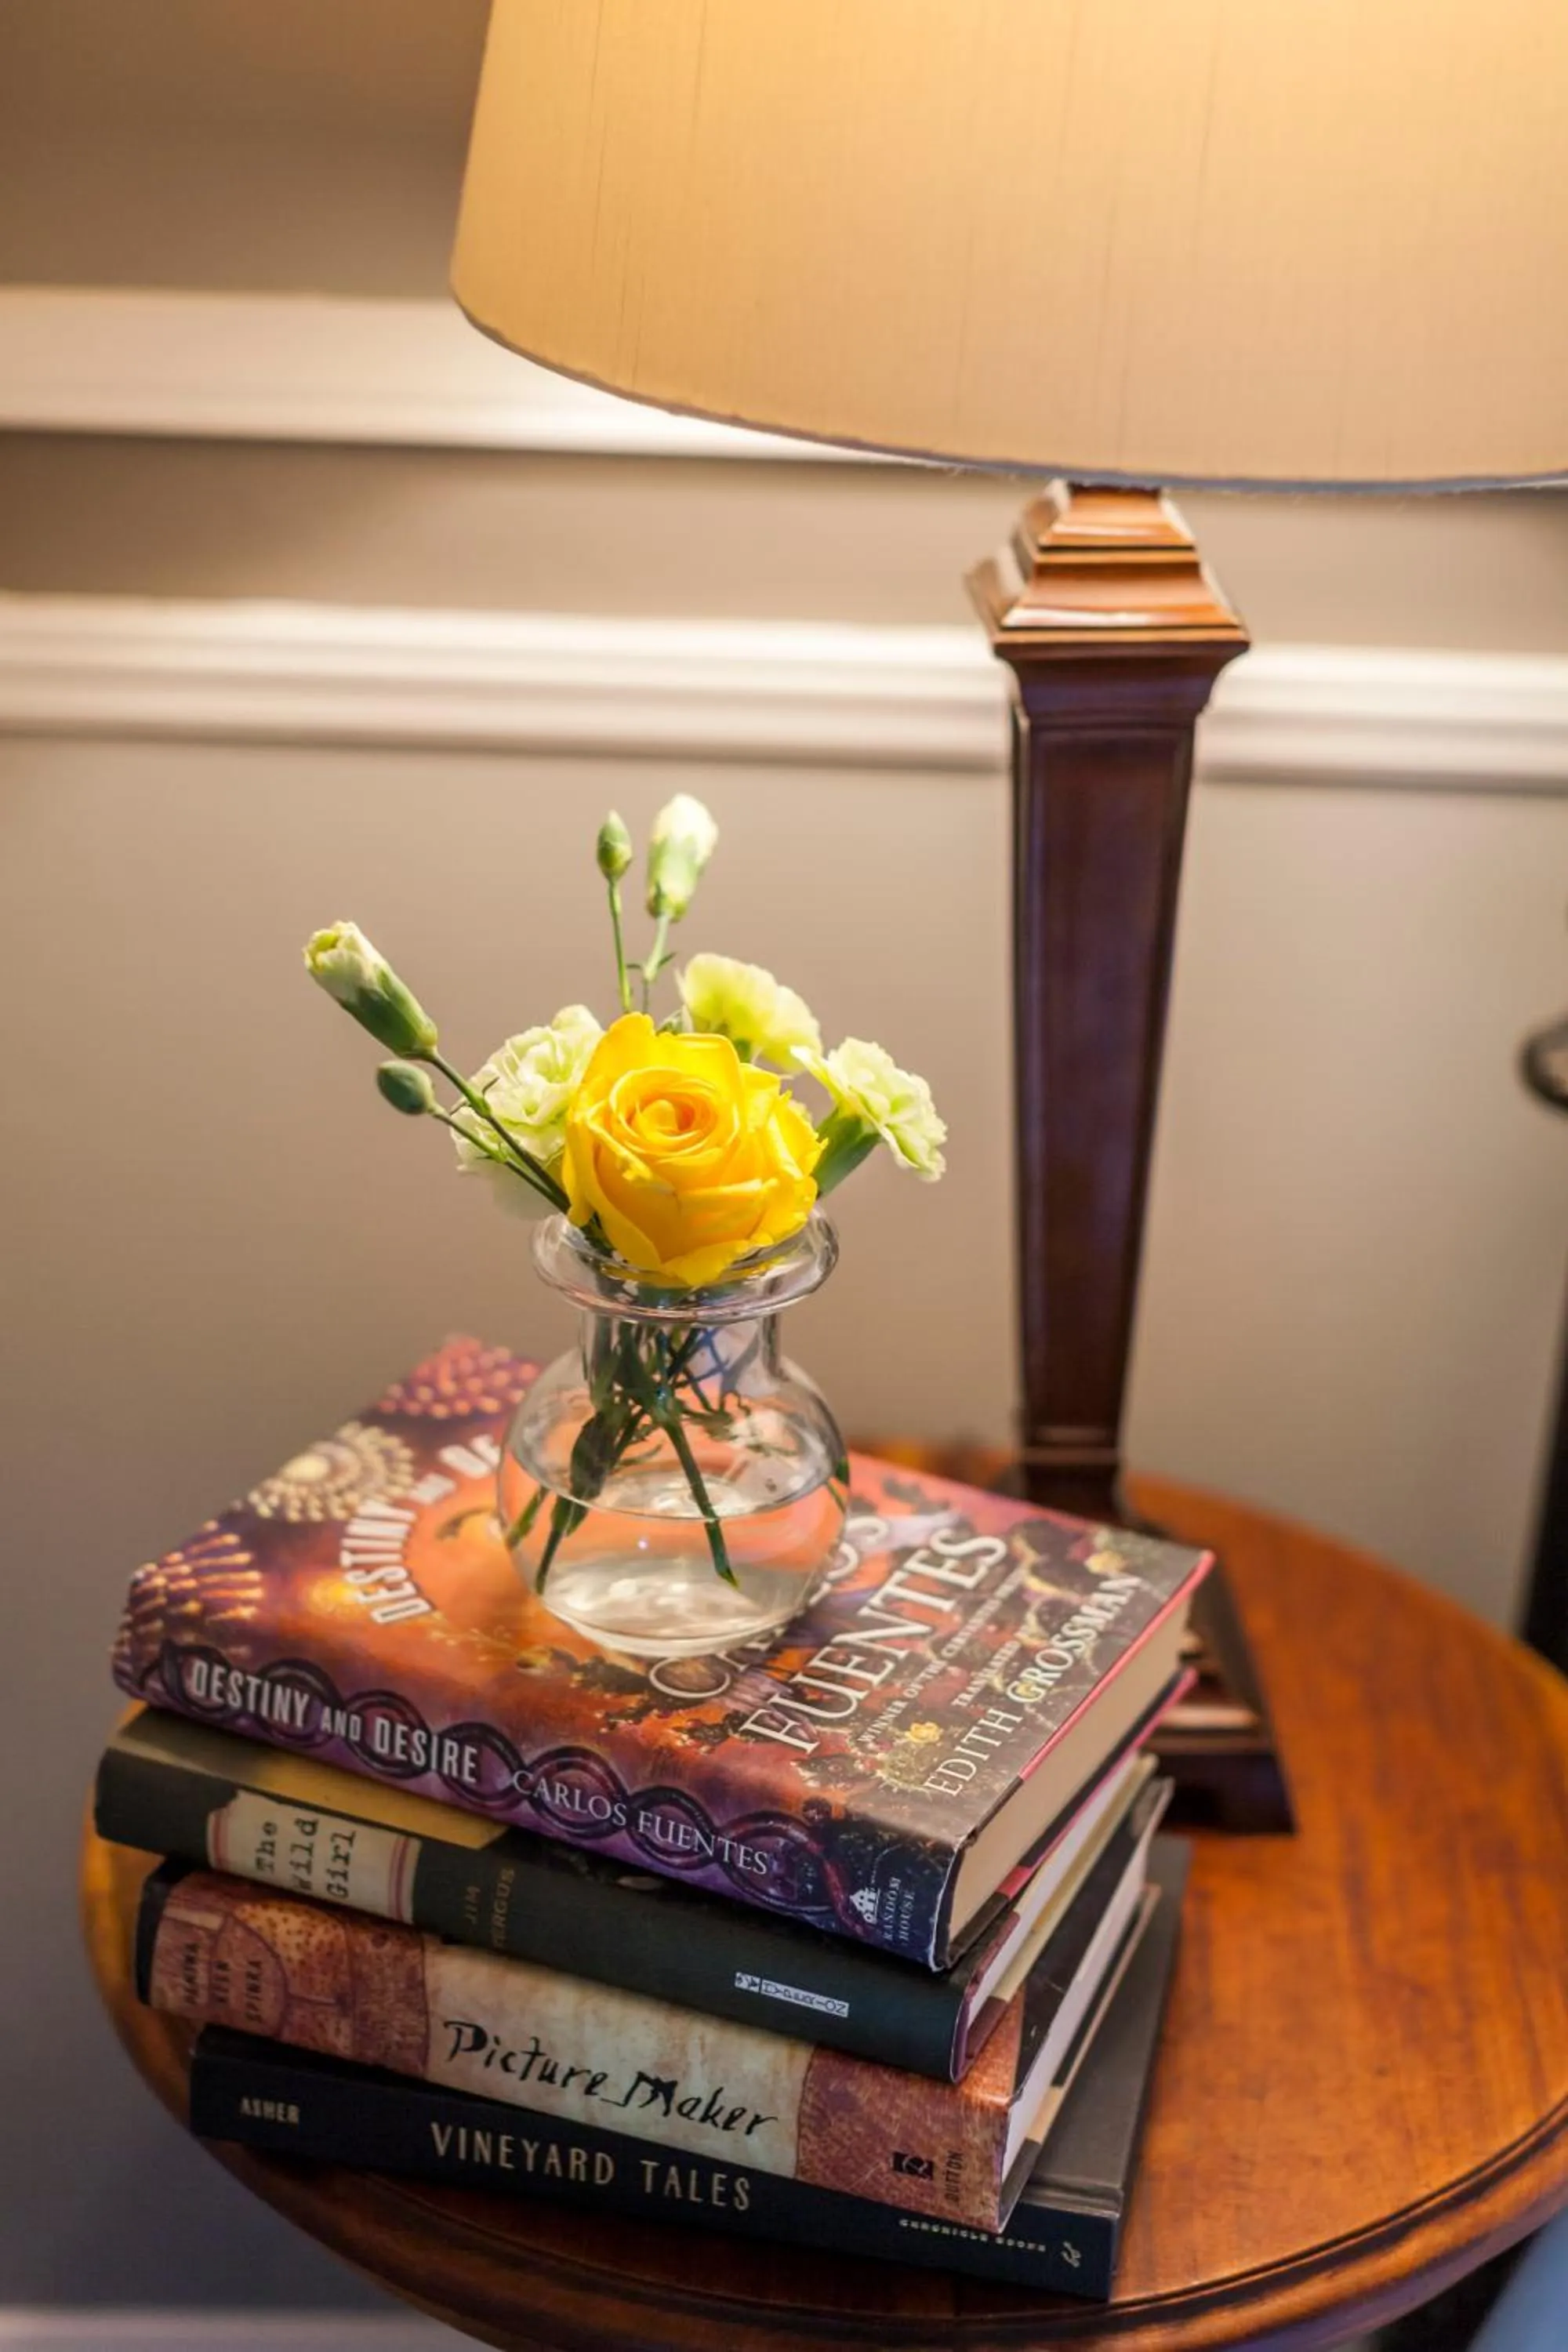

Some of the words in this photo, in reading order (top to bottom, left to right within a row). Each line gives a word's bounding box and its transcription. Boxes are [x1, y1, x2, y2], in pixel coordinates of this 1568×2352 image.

[340, 1498, 432, 1624] DESTINY
[739, 1527, 1007, 1755] FUENTES
[924, 1708, 1023, 1797] EDITH
[1006, 1577, 1142, 1704] GROSSMAN
[192, 1660, 310, 1729] DESTINY
[321, 1707, 361, 1742] AND
[374, 1716, 478, 1784] DESIRE
[858, 1700, 908, 1742] WINNER
[904, 1677, 924, 1699] OF
[255, 1821, 278, 1874] The
[326, 1830, 357, 1899] Girl
[512, 1769, 627, 1827] CARLOS
[638, 1810, 768, 1875] FUENTES
[883, 1877, 902, 1941] RANDOM
[898, 1889, 915, 1941] HOUSE
[444, 2020, 608, 2096] Picture
[601, 2071, 778, 2136] Maker
[430, 2122, 615, 2185] VINEYARD
[640, 2159, 750, 2211] TALES
